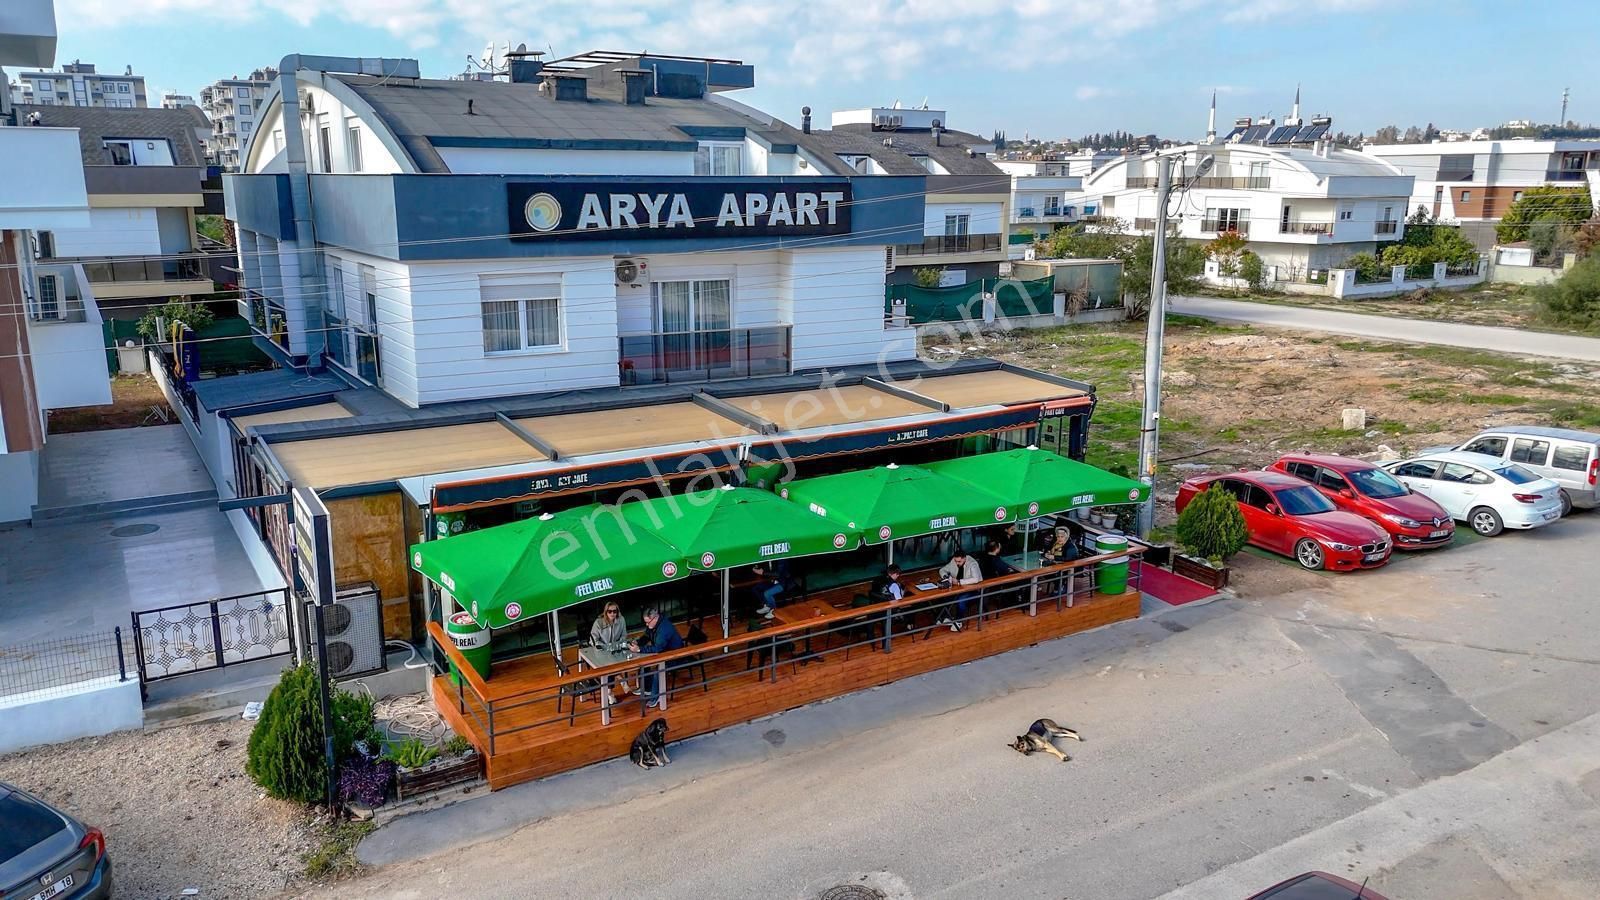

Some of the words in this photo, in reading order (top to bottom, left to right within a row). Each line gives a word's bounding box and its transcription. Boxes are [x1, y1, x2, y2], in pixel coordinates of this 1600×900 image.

[576, 192, 695, 230] ARYA
[716, 191, 844, 228] APART
[761, 544, 774, 557] FEEL
[773, 542, 789, 555] REAL
[578, 582, 594, 598] FEEL
[592, 577, 612, 594] REAL
[459, 637, 476, 647] REAL
